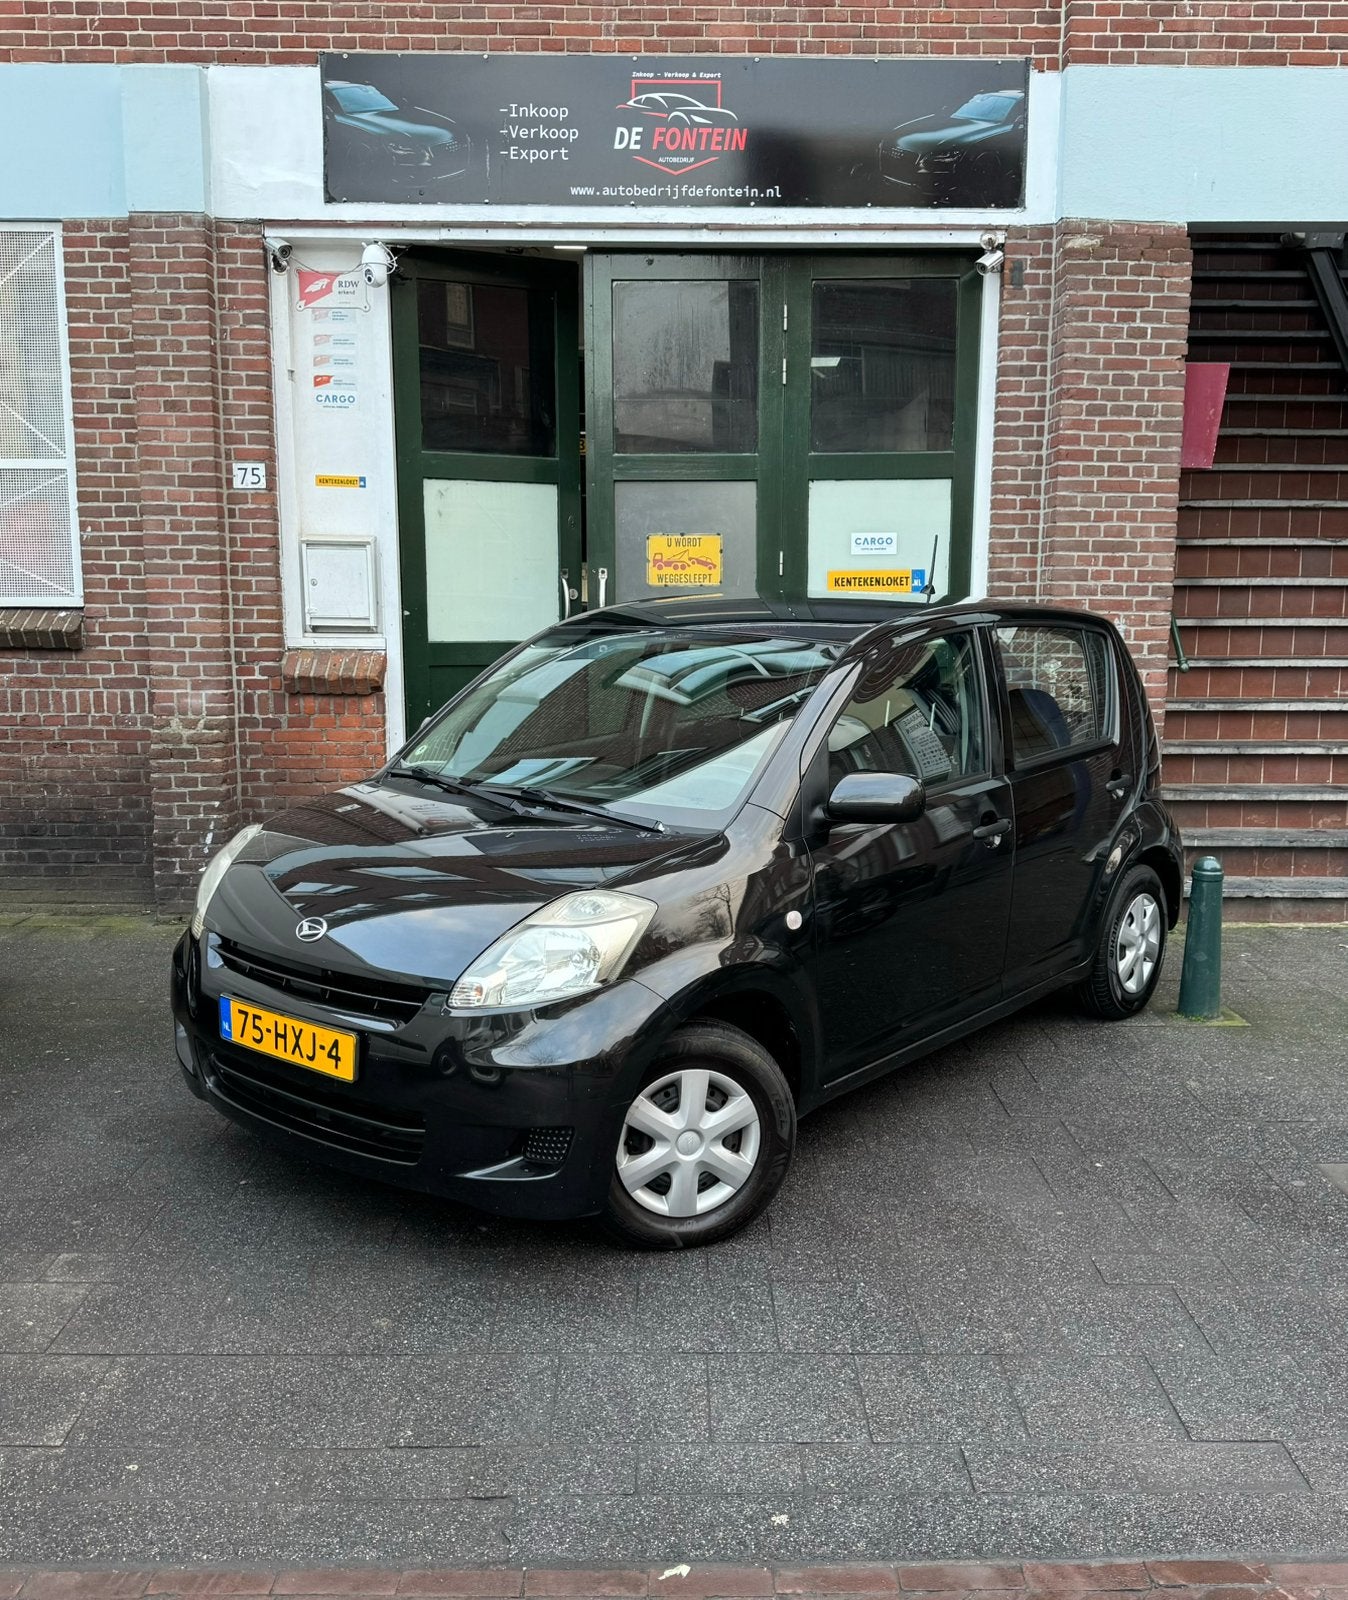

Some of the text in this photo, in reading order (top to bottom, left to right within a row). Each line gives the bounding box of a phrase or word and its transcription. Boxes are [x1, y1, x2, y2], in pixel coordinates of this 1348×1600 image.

[613, 127, 748, 151] DE FONTEIN
[658, 156, 695, 164] AUTOBEDRIJF
[570, 185, 782, 199] www.autobedrijfdefontein.nl
[338, 280, 360, 288] RDW
[316, 394, 356, 403] CARGO
[237, 467, 262, 486] 75
[666, 537, 702, 547] U WORDT
[854, 537, 893, 546] CARGO
[657, 573, 713, 584] WEGGESLEEPT
[834, 576, 910, 587] KENTEKENLOKET
[237, 1009, 342, 1070] 75-HXJ-4
